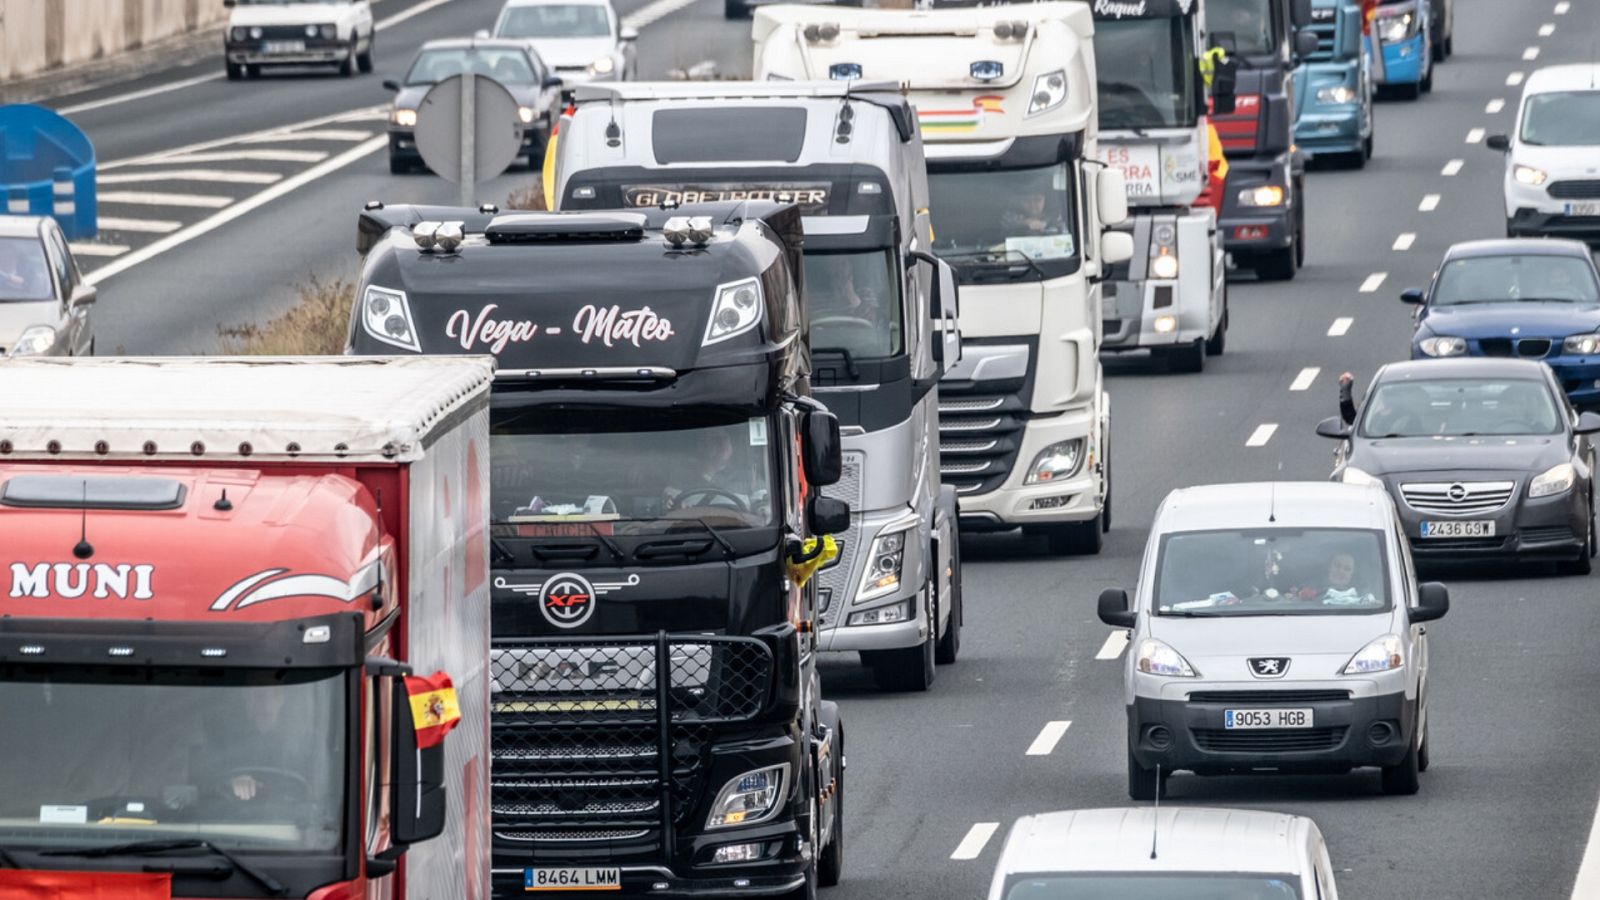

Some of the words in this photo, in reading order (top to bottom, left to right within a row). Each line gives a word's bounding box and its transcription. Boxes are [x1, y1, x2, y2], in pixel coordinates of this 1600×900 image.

[1094, 0, 1146, 19] Raquel
[1107, 147, 1129, 164] ES
[446, 303, 538, 354] Vega
[572, 304, 675, 348] Mateo
[1429, 523, 1462, 536] 2436
[8, 563, 155, 600] MUNI
[546, 594, 591, 607] XF
[1235, 711, 1271, 726] 9053
[1278, 711, 1305, 726] HGB
[537, 869, 580, 885] 8464
[585, 869, 617, 885] LMM
